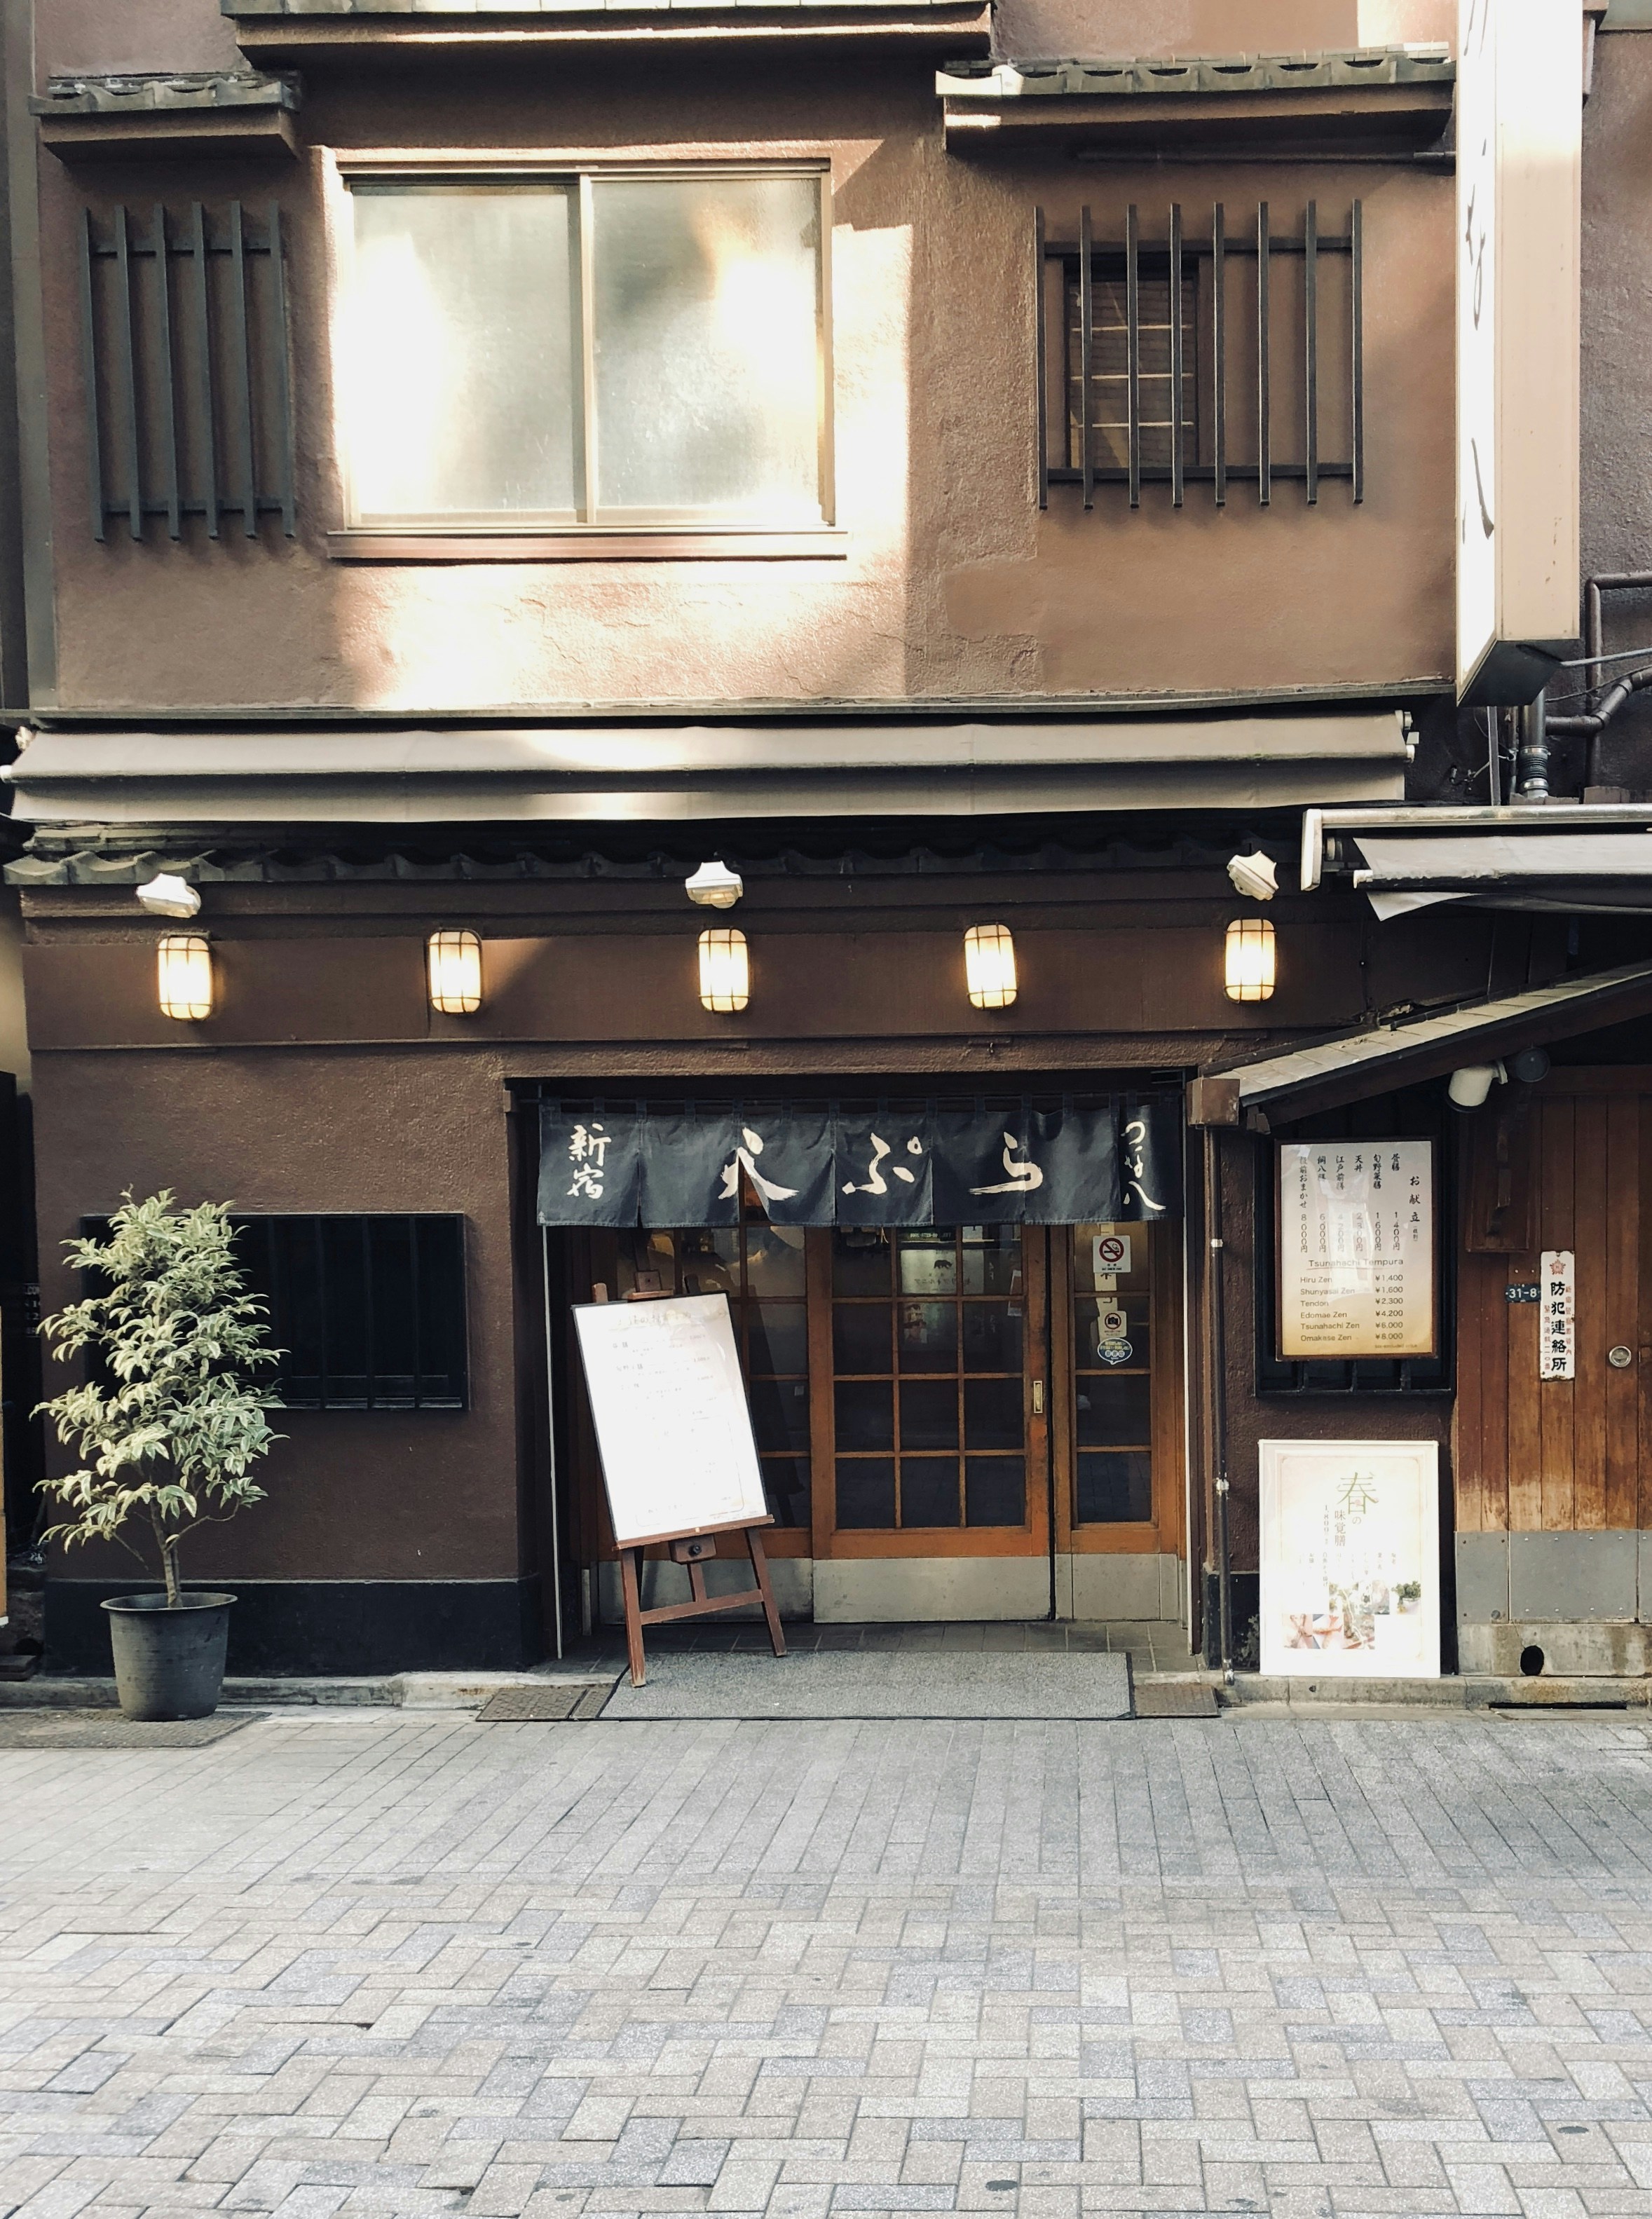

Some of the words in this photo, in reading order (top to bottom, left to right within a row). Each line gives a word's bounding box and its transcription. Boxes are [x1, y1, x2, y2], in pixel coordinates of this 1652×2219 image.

[566, 1123, 612, 1199] 新宿
[1300, 1288, 1339, 1296] Shunyasai
[1550, 1281, 1567, 1372] 防犯連絡所
